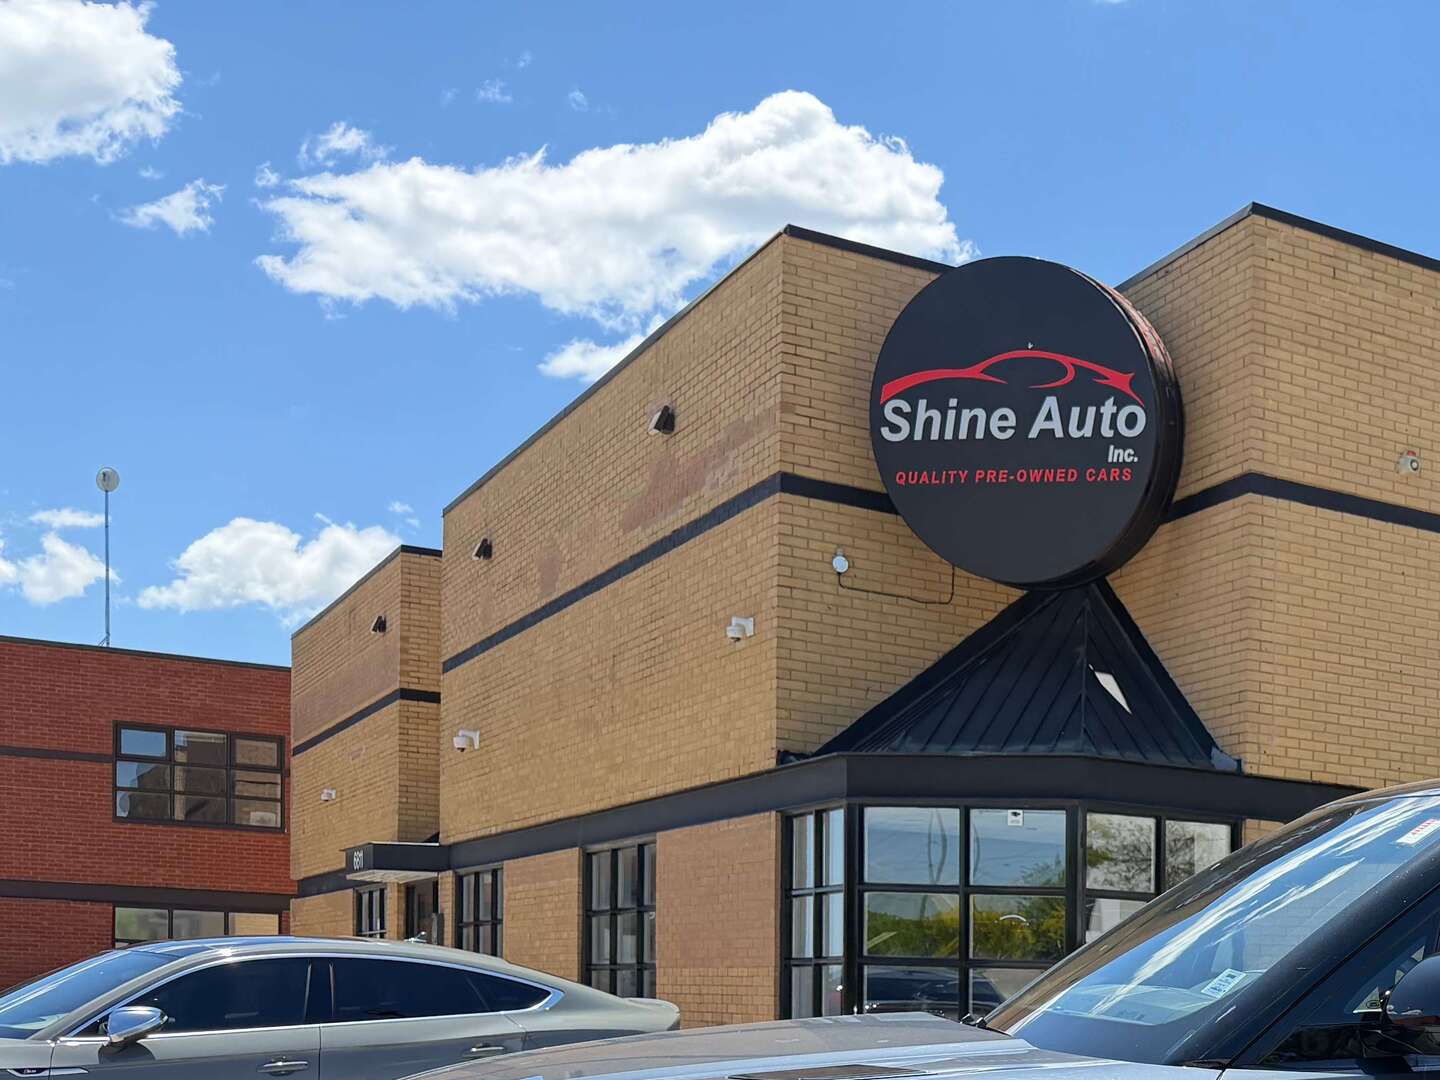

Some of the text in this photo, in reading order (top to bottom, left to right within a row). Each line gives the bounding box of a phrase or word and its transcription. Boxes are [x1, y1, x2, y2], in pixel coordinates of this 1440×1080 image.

[880, 396, 1147, 442] Shine Auto
[1107, 445, 1138, 463] Inc.
[895, 468, 1133, 486] QUALITY PRE-OWNED CARS
